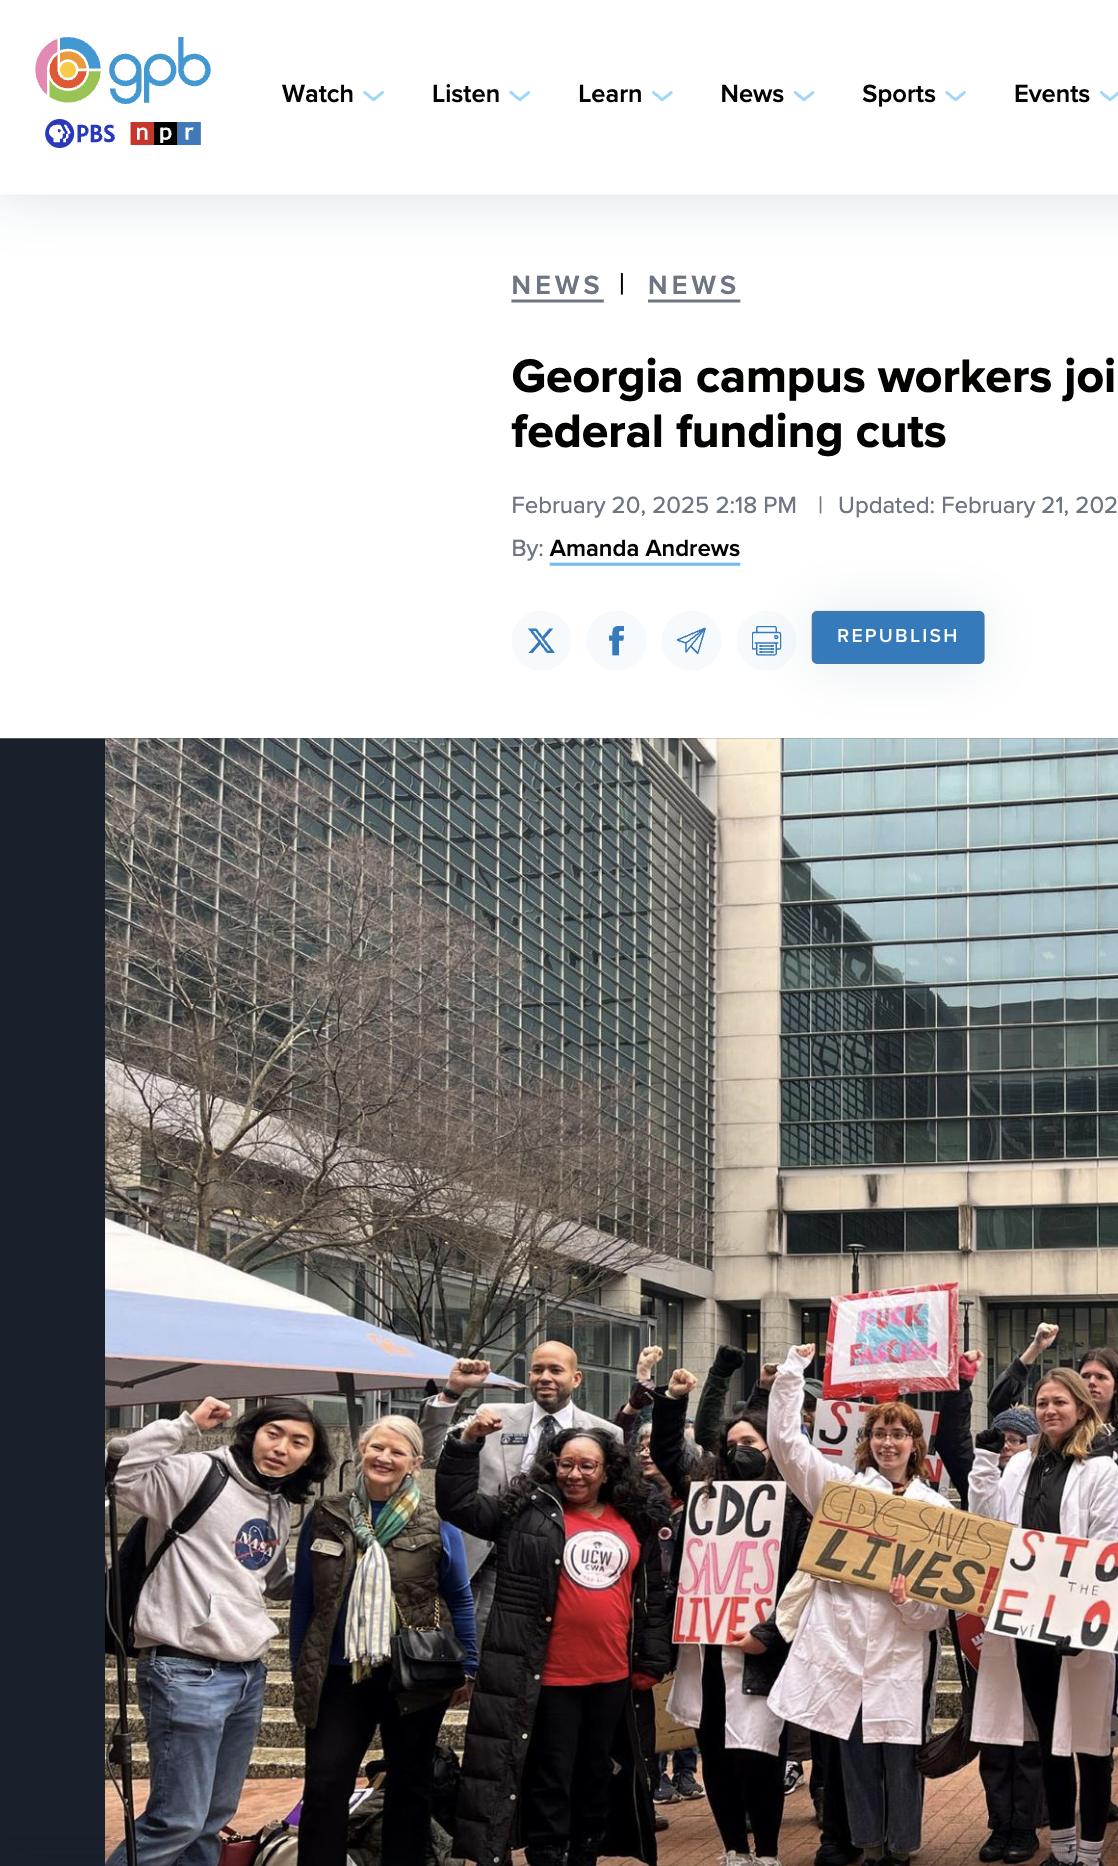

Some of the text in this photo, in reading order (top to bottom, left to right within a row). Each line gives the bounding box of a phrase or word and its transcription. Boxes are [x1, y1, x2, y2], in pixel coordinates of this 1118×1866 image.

[109, 36, 211, 104] gpb
[282, 84, 353, 103] Watch
[433, 84, 499, 103] Listen
[580, 84, 641, 103] Learn
[722, 84, 784, 103] News
[863, 84, 936, 107] Sports
[1015, 84, 1090, 103] Events
[77, 124, 115, 143] PBS
[136, 126, 194, 143] npr
[512, 275, 600, 295] NEWS
[648, 275, 737, 295] NEWS
[512, 357, 682, 402] Georgia
[697, 367, 865, 402] campus
[877, 359, 1051, 393] workers
[511, 412, 946, 457] federal funding cuts
[512, 496, 796, 519] February 20, 2025 2:18 PM
[839, 496, 934, 519] Updated:
[943, 496, 1036, 519] February
[1042, 496, 1068, 517] 21,
[512, 539, 740, 562] By: Amanda Andrews
[837, 628, 957, 643] REPUBLISH
[859, 1303, 923, 1333] FUCK
[850, 1339, 938, 1367] FASCISM
[688, 1484, 777, 1538] CDC
[821, 1484, 997, 1560] CDC SAVES
[239, 1530, 273, 1558] NASA
[581, 1549, 612, 1566] UCW
[585, 1564, 605, 1573] CWA
[677, 1538, 780, 1595] SAVES
[815, 1528, 1000, 1614] LIVES!
[1068, 1581, 1099, 1597] THE
[673, 1596, 773, 1643] LIVES
